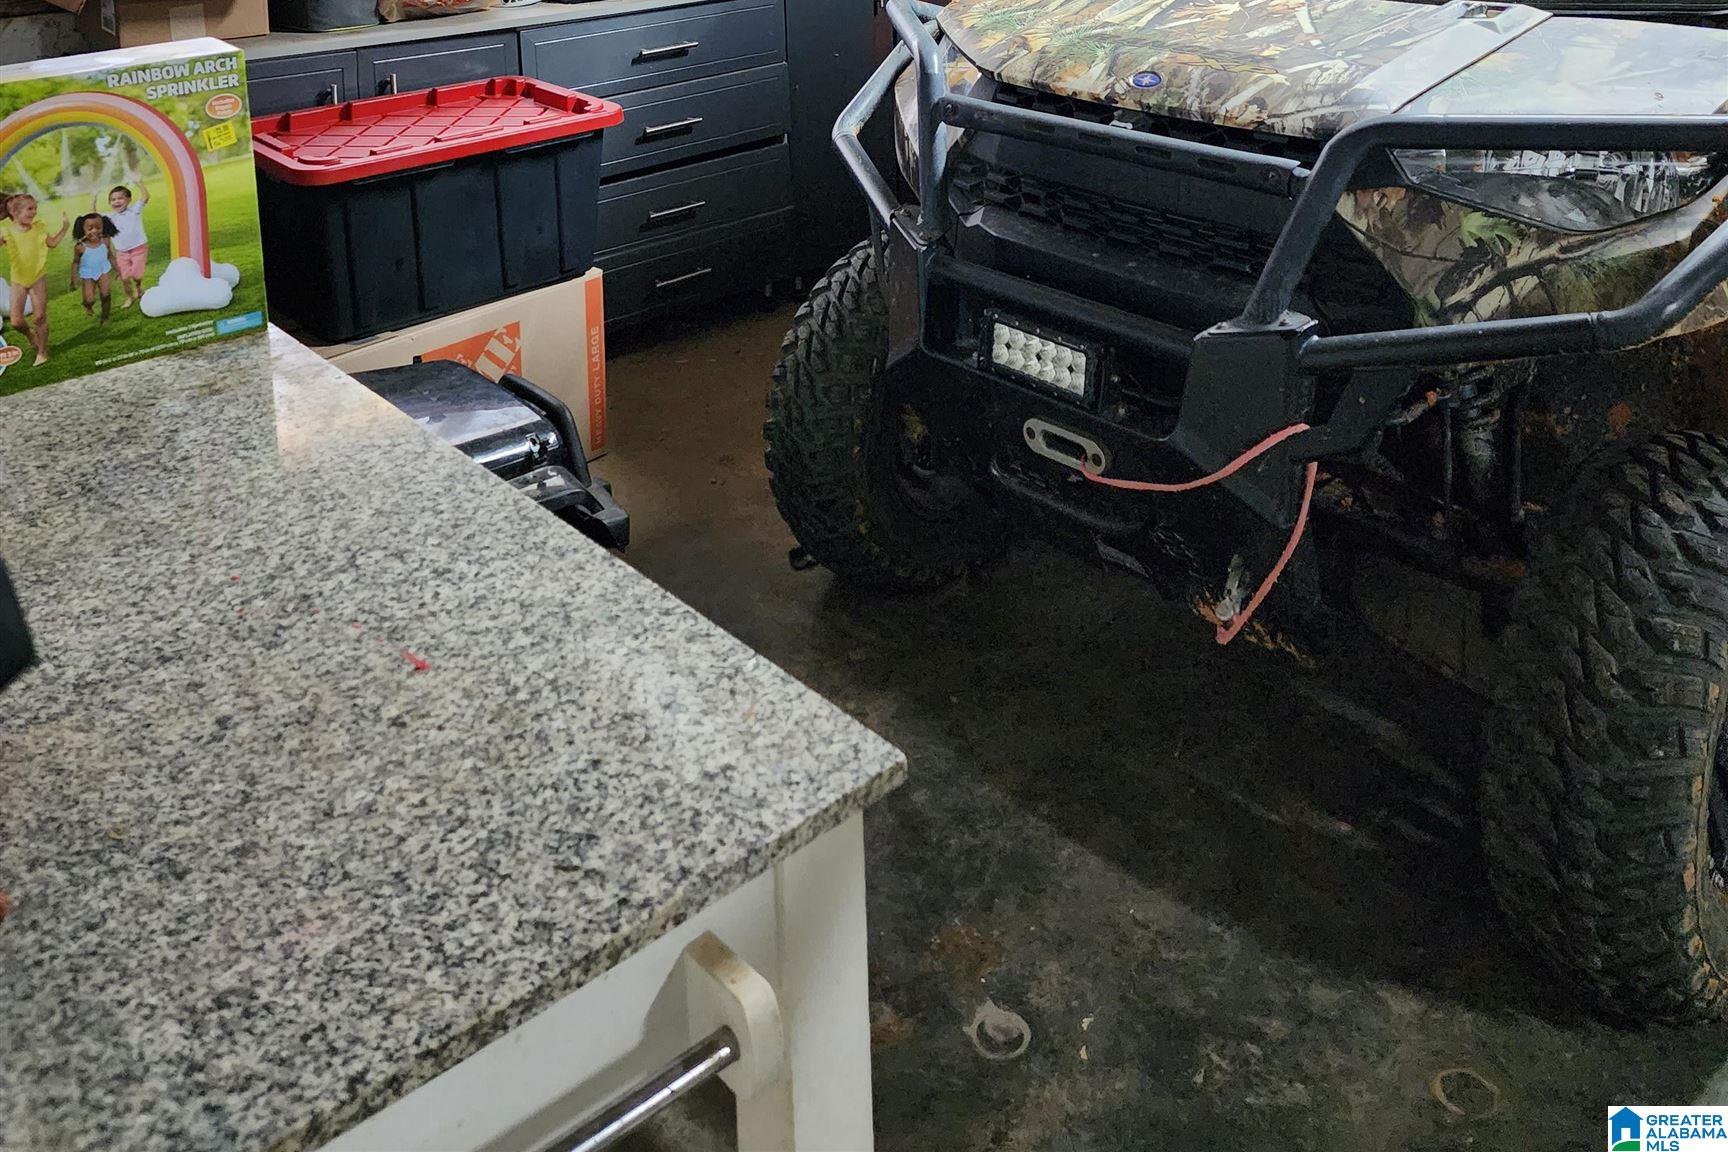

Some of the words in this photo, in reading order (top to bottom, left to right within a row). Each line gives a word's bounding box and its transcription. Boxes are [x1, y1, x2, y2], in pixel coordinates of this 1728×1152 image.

[107, 63, 190, 88] RAINBOW
[193, 56, 237, 76] ARCH
[146, 73, 239, 100] SPRINKLER
[590, 326, 601, 372] LARGE
